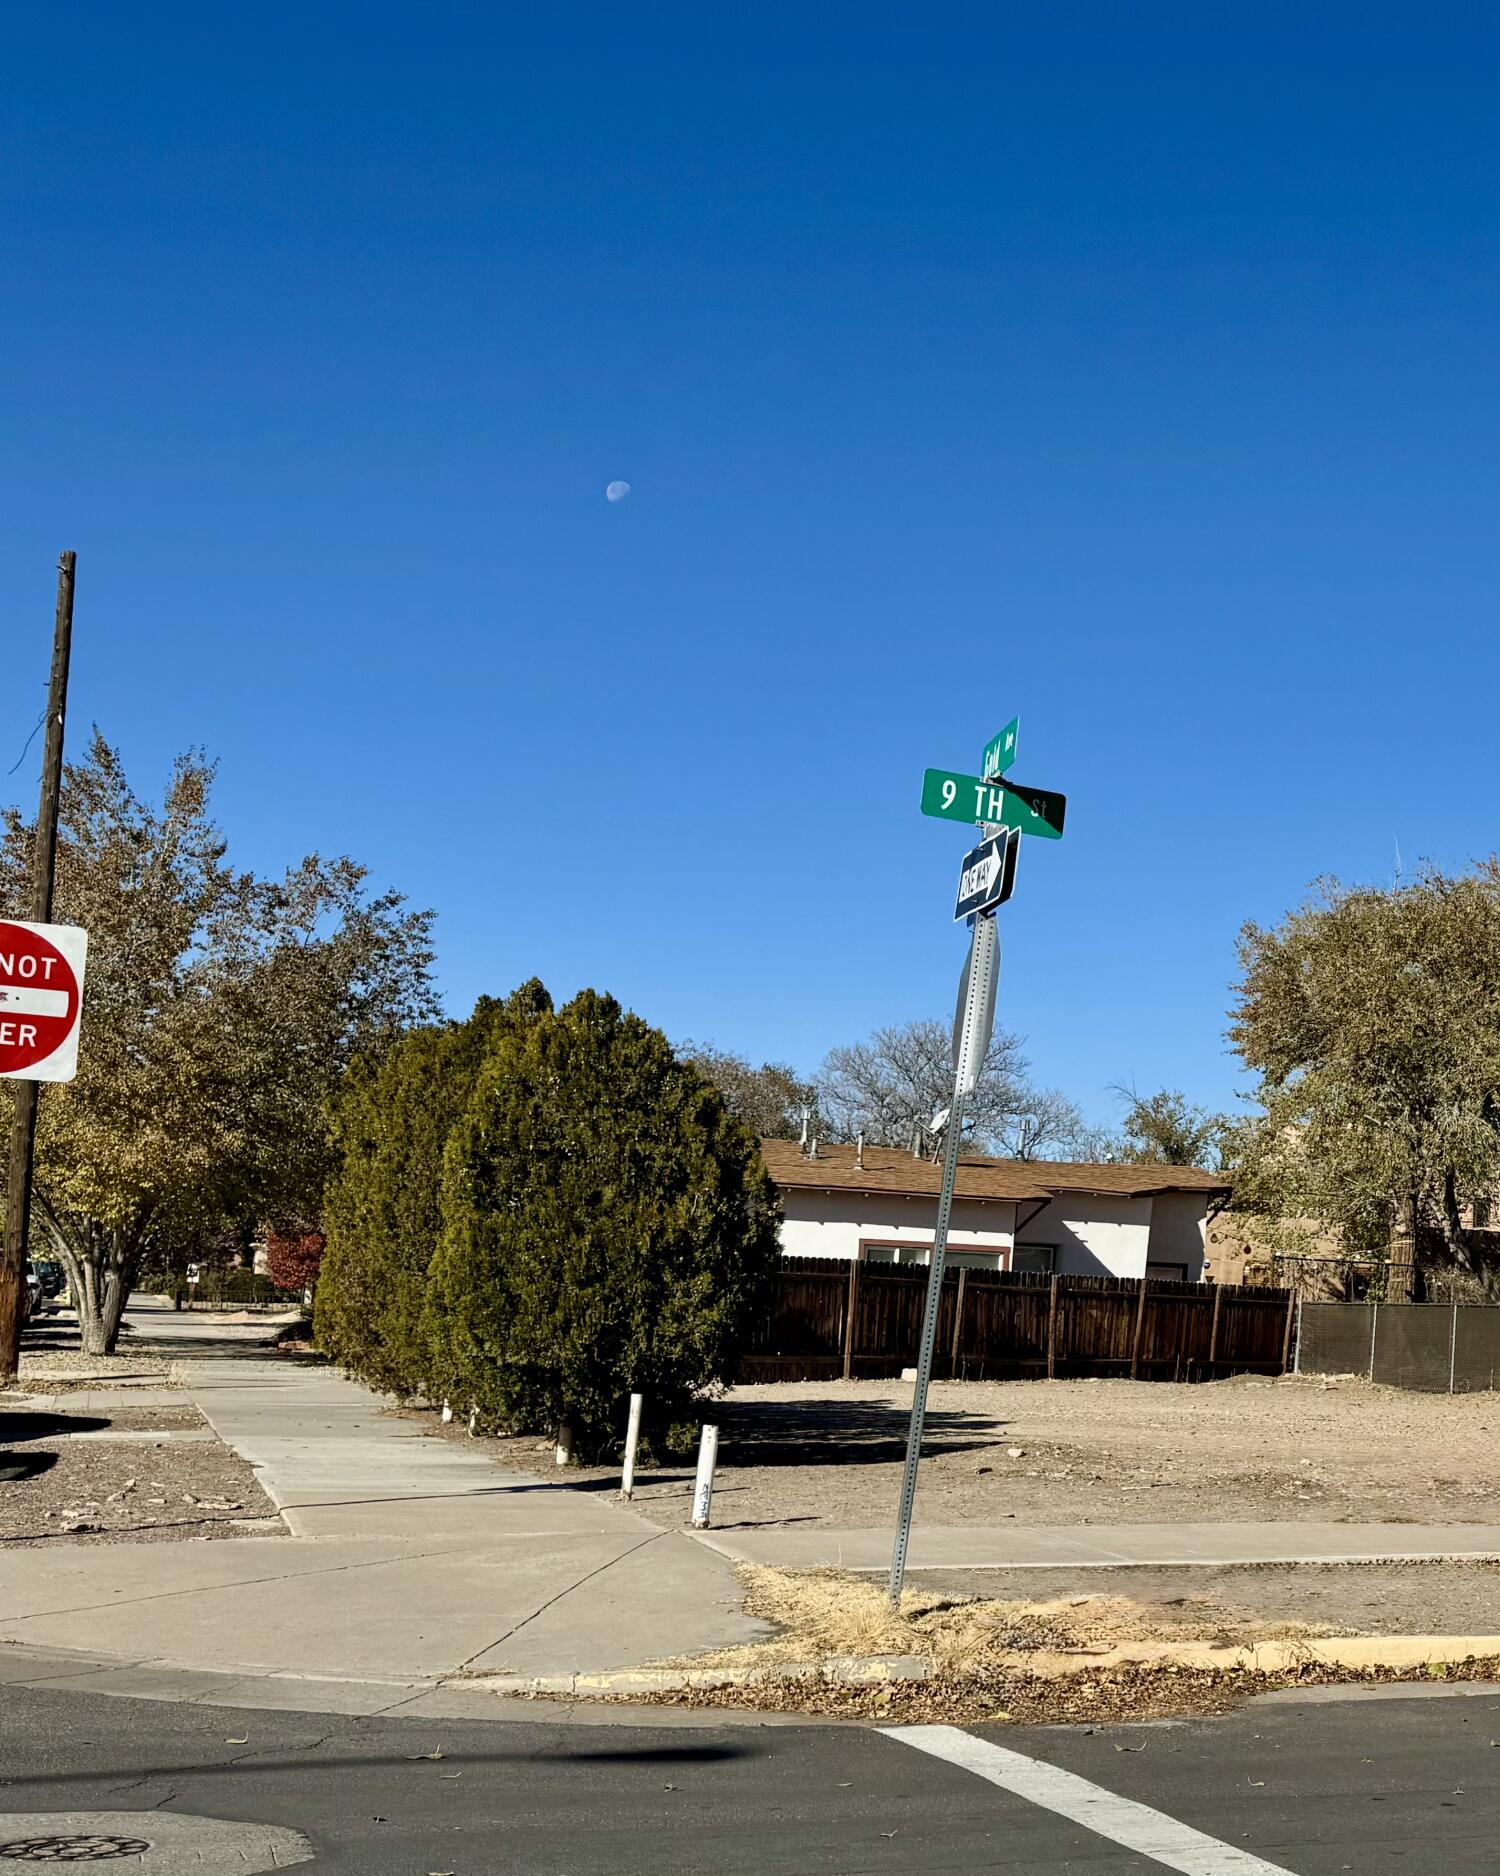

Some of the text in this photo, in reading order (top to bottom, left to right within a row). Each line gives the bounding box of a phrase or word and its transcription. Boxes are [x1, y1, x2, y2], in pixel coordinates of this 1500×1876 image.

[941, 780, 1047, 821] 9 TH St
[961, 861, 992, 898] ONE WAY
[0, 953, 57, 980] NOT
